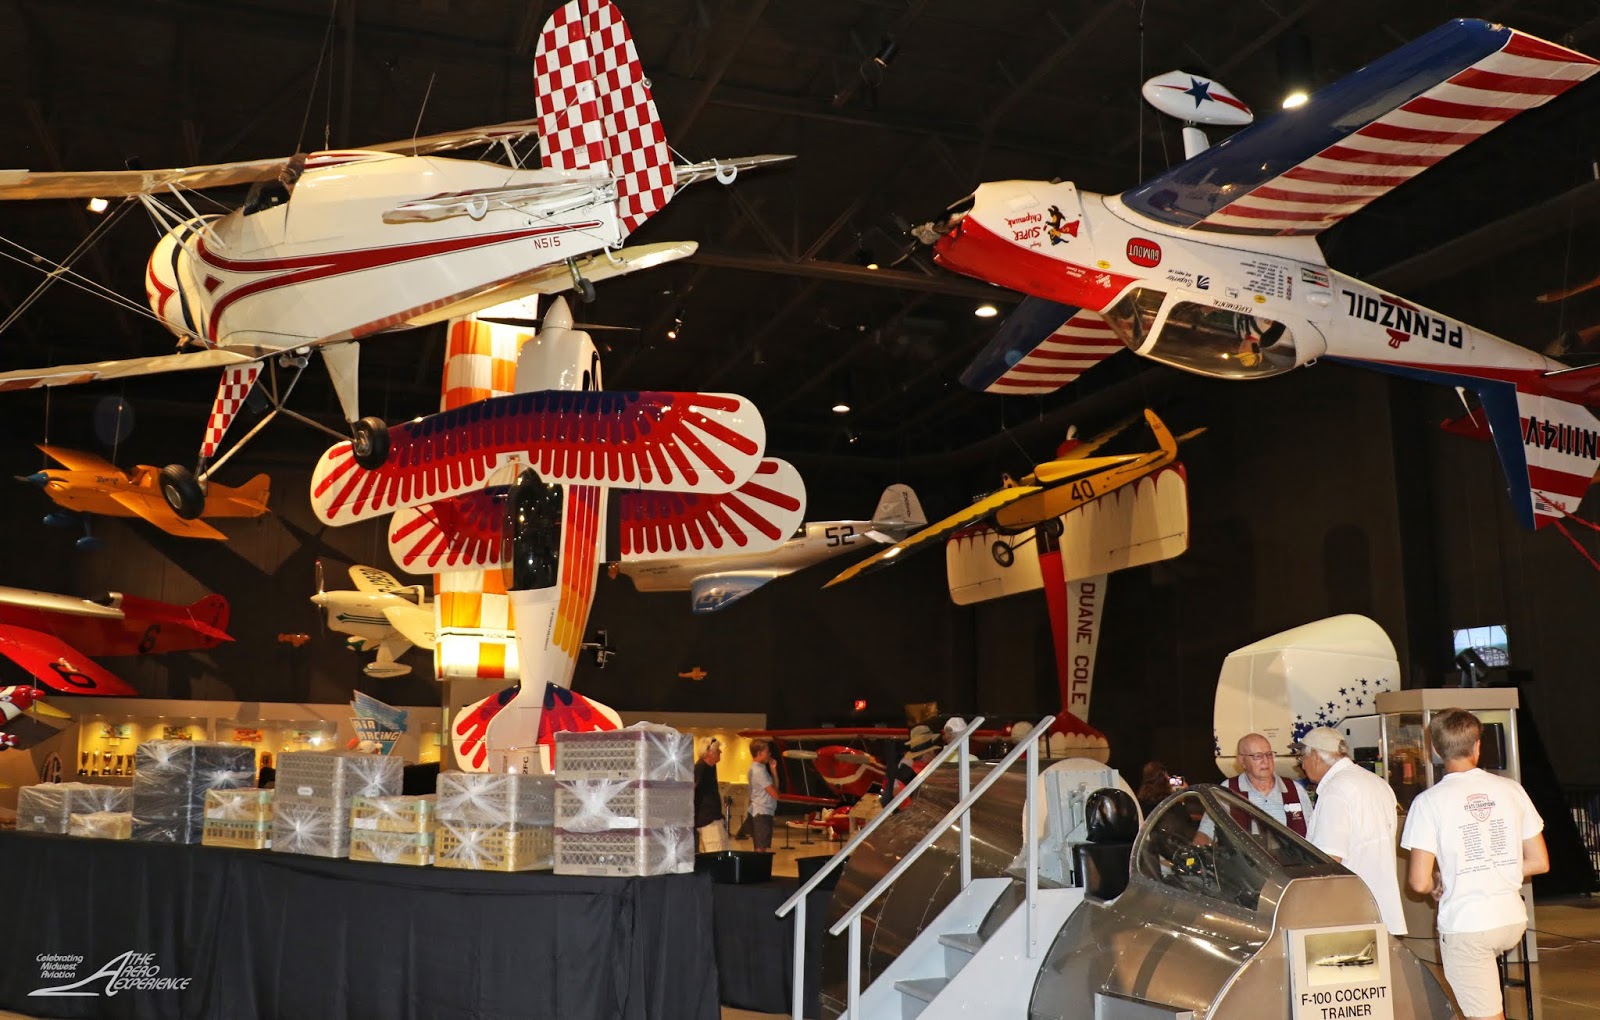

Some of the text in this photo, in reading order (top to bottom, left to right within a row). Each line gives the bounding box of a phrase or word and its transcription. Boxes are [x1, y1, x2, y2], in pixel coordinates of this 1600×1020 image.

[1004, 212, 1042, 228] Chipmunk
[533, 236, 561, 249] N515
[1013, 226, 1041, 241] SUPER
[1129, 244, 1159, 261] GUMOUT
[1166, 275, 1193, 287] Superior
[1213, 299, 1252, 314] EXPERIMENTAL
[1342, 289, 1462, 349] PENNZOIL
[1525, 416, 1597, 460] N1114V
[1071, 479, 1095, 501] 40
[825, 525, 855, 547] 52
[138, 624, 161, 653] 6
[1071, 582, 1095, 705] DUANE COLE
[1301, 986, 1387, 1006] F-100 COCKPIT
[1321, 1004, 1372, 1020] TRAINER
